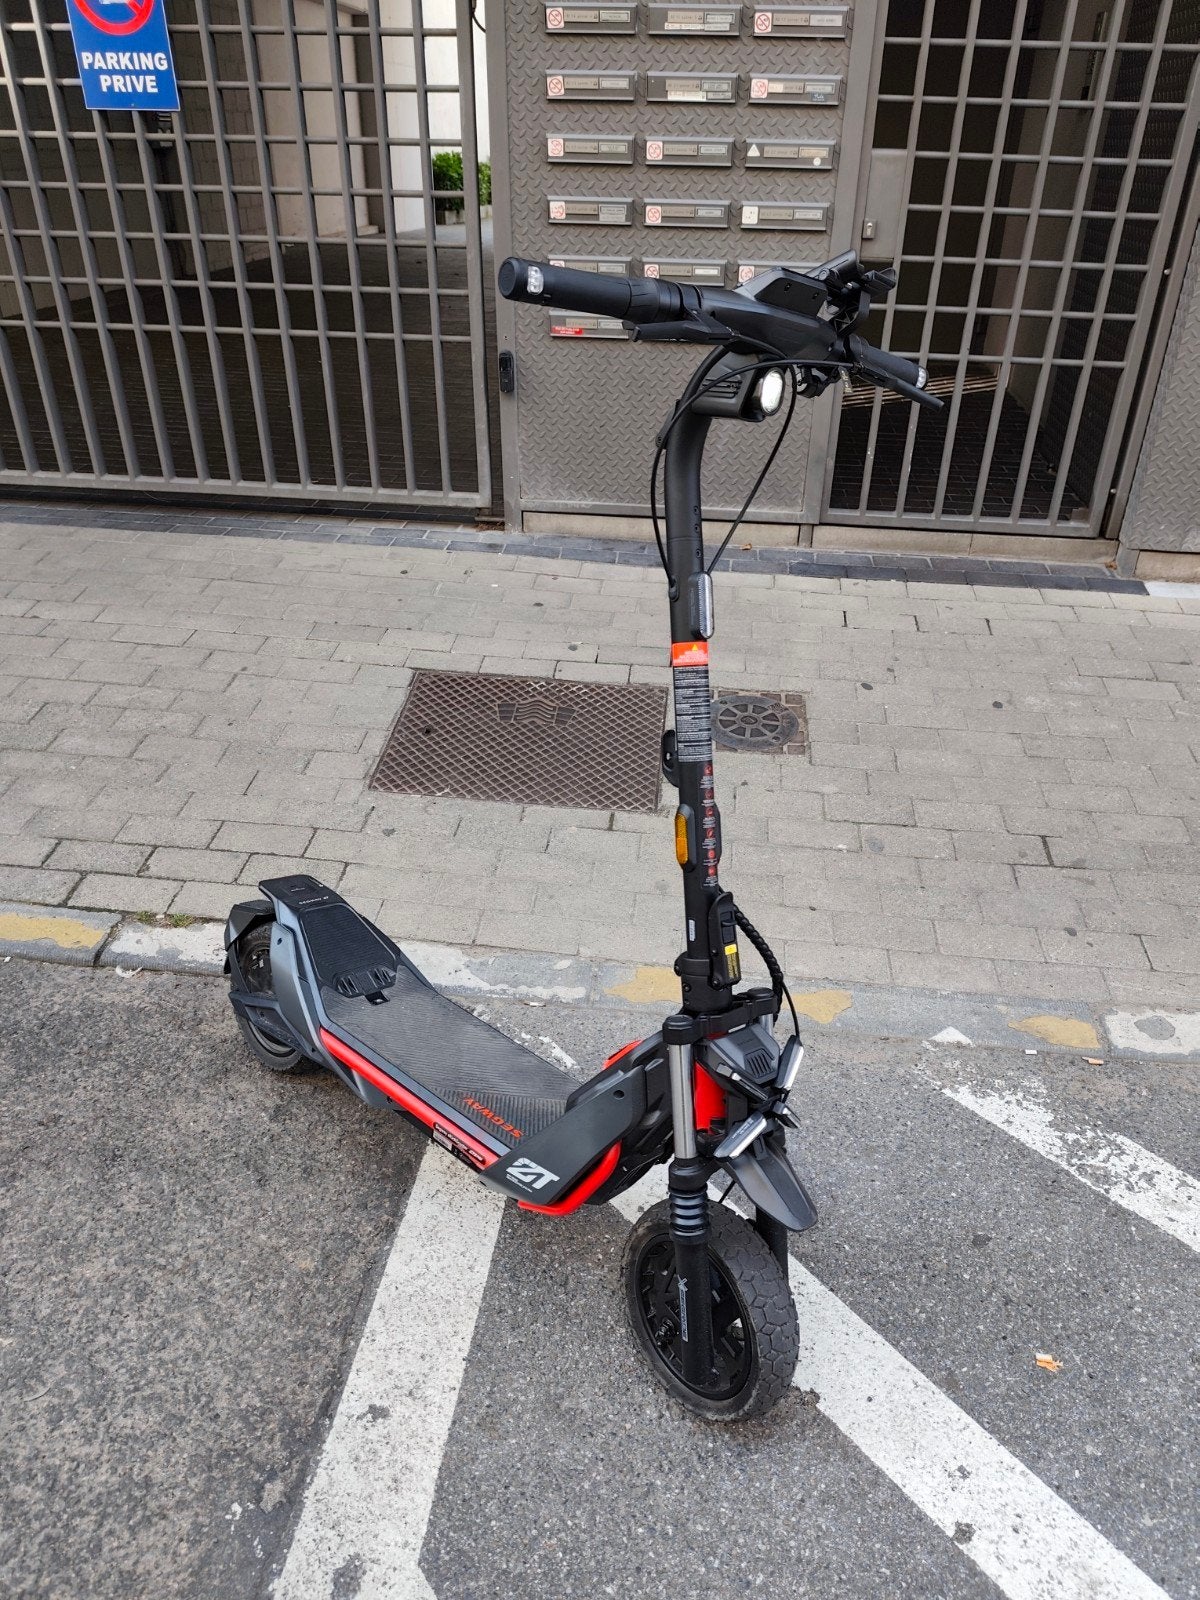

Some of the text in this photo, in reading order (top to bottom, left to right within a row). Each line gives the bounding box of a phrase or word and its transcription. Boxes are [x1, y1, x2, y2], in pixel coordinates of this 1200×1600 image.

[81, 51, 169, 71] PARKING
[99, 74, 159, 93] PRIVE
[462, 1096, 525, 1140] SEGWAY
